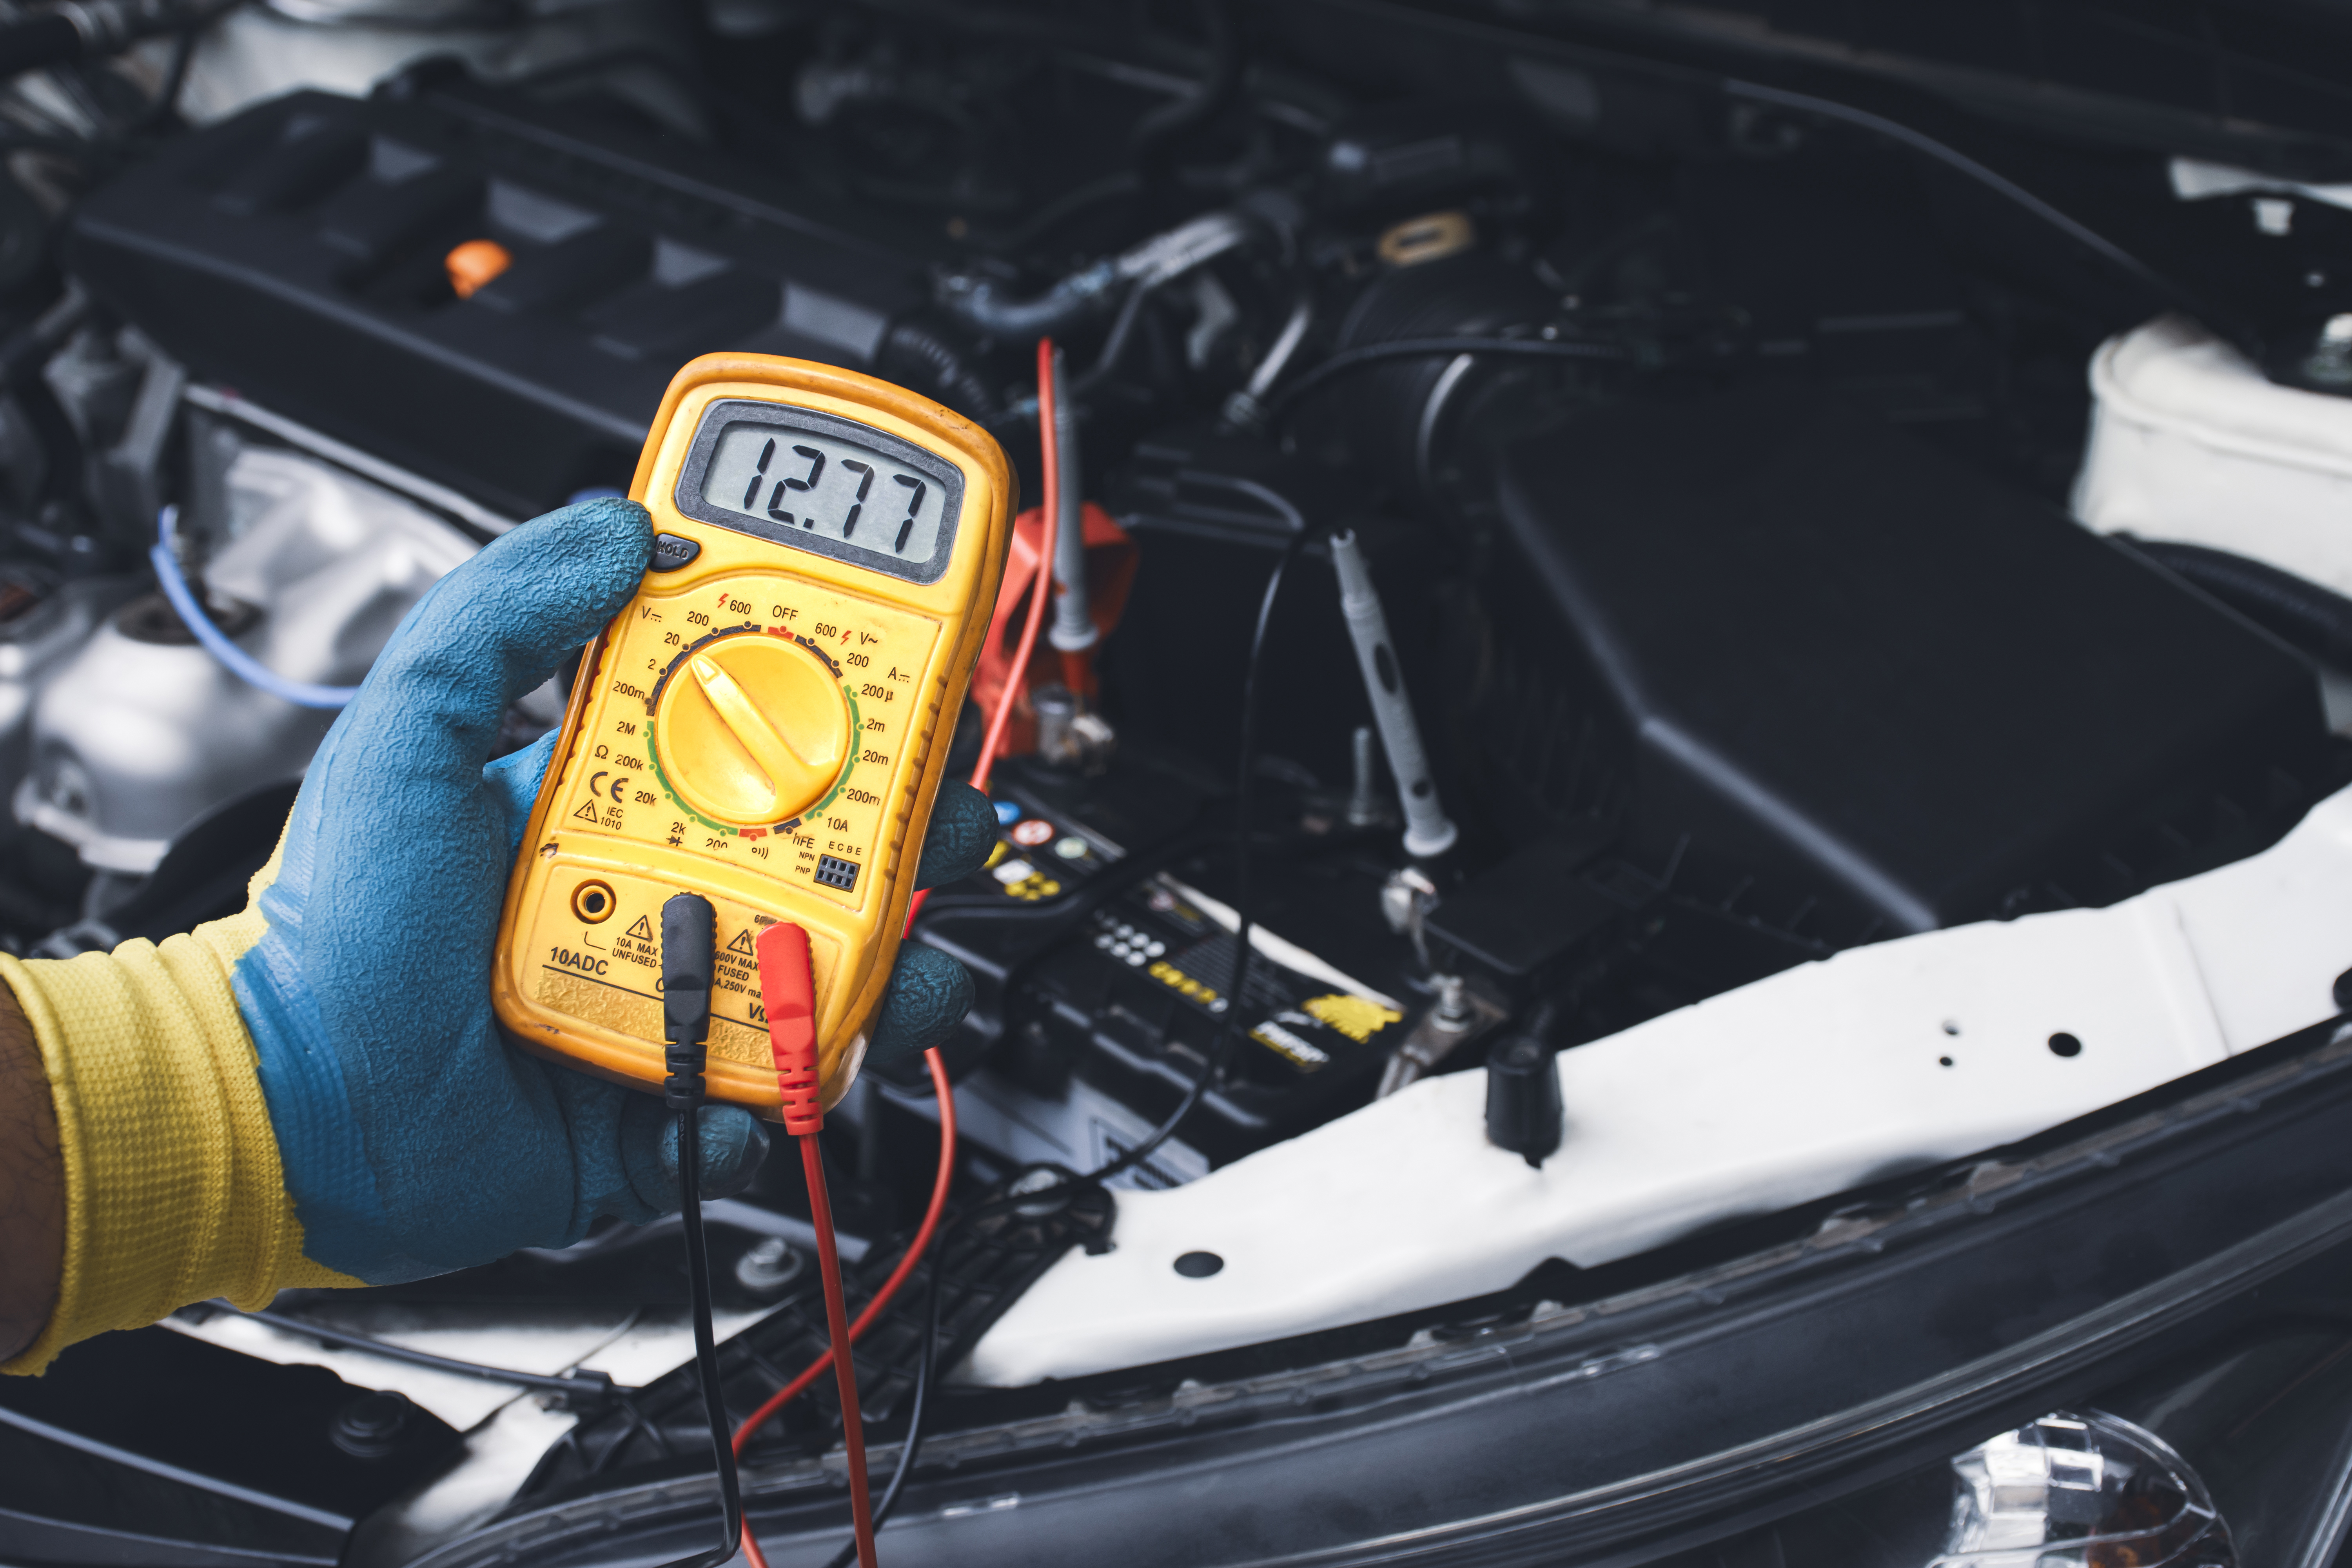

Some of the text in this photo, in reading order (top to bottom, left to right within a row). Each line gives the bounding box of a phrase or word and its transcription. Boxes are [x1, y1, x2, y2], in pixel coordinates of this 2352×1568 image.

[744, 437, 926, 553] 12.77
[656, 541, 688, 560] HOLD
[730, 600, 751, 615] 600
[772, 605, 798, 621] OFF
[686, 611, 709, 626] 200
[815, 622, 837, 637] 600
[664, 632, 680, 646] 20
[648, 659, 656, 670] 2
[846, 652, 869, 668] 200
[612, 681, 645, 699] 200m
[617, 721, 636, 735] 2M
[866, 718, 885, 732] 2m
[615, 754, 644, 771] 200k
[862, 750, 888, 766] 20m
[634, 791, 657, 806] 20k
[846, 788, 880, 806] 200m
[606, 806, 623, 818] IEC
[600, 817, 622, 830] 1010
[671, 822, 686, 835] 2k
[827, 817, 848, 832] 10A
[799, 851, 815, 861] NPN
[795, 865, 810, 874] PNP
[617, 937, 659, 956] 10A MAX
[550, 946, 608, 975] 10ADC
[612, 947, 657, 968] UNFUSED
[715, 951, 759, 971] 600V MAX
[717, 964, 749, 981] FUSED
[748, 989, 762, 999] ma
